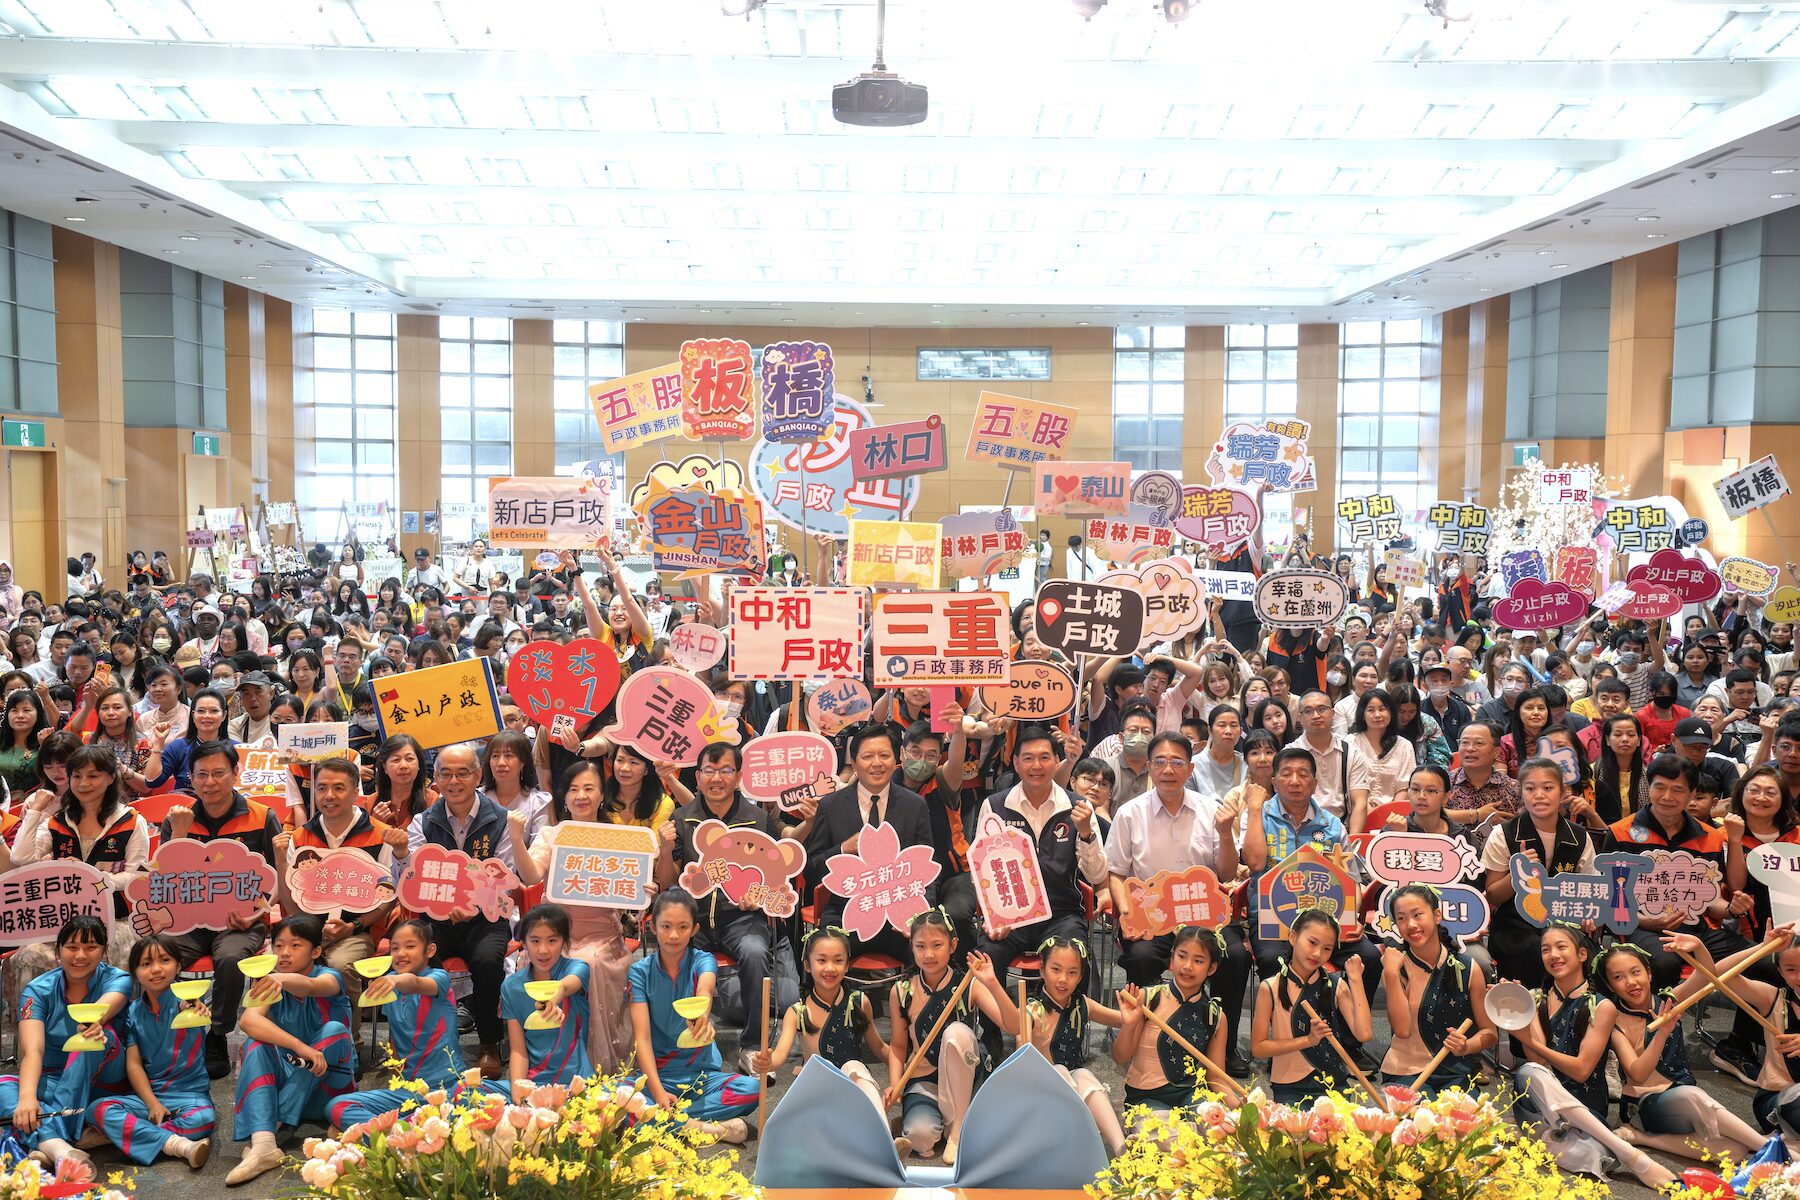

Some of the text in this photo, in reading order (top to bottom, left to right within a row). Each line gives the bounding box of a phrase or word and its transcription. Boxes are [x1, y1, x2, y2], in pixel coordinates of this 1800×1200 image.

[690, 357, 748, 415] 板
[768, 361, 828, 418] 橋
[597, 373, 682, 426] 五股
[610, 415, 680, 444] 戶政事務所
[700, 421, 738, 431] BANQIAO
[778, 422, 818, 433] BANQIAO
[979, 403, 1070, 449] 五股
[863, 431, 932, 471] 林口
[975, 441, 1046, 462] 戶政事務所
[1227, 434, 1281, 461] 瑞芳
[1043, 474, 1124, 498] I 泰山
[1241, 461, 1293, 487] 戶政
[1543, 473, 1571, 487] 中和
[773, 480, 834, 513] 戶政
[1558, 489, 1588, 502] 戶政
[1725, 466, 1782, 510] 板橋
[494, 498, 604, 526] 新店戶政
[650, 496, 743, 535] 金山
[1182, 489, 1234, 518] 瑞芳
[1339, 493, 1395, 521] 中和
[1430, 503, 1487, 529] 中和
[1203, 515, 1251, 541] 戶政
[1350, 519, 1404, 542] 戶政
[1606, 505, 1667, 531] 中和
[1684, 521, 1703, 531] 中和
[491, 530, 547, 540] Let's Celebrate!
[692, 530, 750, 561] 戶政
[942, 531, 1024, 558] 樹林戶政
[1089, 519, 1173, 548] 樹林戶政
[1435, 529, 1490, 556] 戶政
[1617, 530, 1674, 554] 戶政
[663, 552, 718, 566] JINSHAN
[853, 541, 936, 567] 新店戶政
[1559, 556, 1594, 588] 板
[1645, 567, 1706, 584] 汐止戶政
[1063, 586, 1123, 619] 土城
[1272, 581, 1303, 598] 幸福
[740, 595, 811, 631] 中和
[1146, 594, 1190, 616] 戶政
[1284, 598, 1333, 617] 在蘆洲
[1510, 592, 1571, 614] 汐止戶政
[1633, 606, 1660, 614] Xizhi
[880, 597, 1002, 658] 三重
[1523, 611, 1559, 624] Xizhi
[672, 627, 718, 656] 林口
[1061, 620, 1120, 652] 戶政
[520, 648, 596, 682] 淡水
[781, 638, 854, 673] 戶政
[911, 659, 1004, 675] 戶政事務所
[817, 681, 858, 712] 泰山
[1000, 678, 1063, 691] ove in
[645, 685, 696, 728] 三重
[1008, 696, 1045, 713] 永和
[555, 715, 573, 727] 淡水
[289, 734, 337, 749] 土城戶所
[636, 719, 692, 761] 戶政
[748, 745, 825, 768] 三重戶政
[421, 859, 460, 881] 我愛
[564, 854, 641, 877] 新北多元
[704, 858, 731, 886] 熊
[1384, 848, 1444, 872] 我愛
[3, 873, 83, 904] 三重戶政
[149, 870, 263, 904] 新莊戶政
[315, 868, 374, 885] 淡水戶政
[562, 874, 638, 900] 大家庭
[841, 860, 912, 896] 多元新力
[1283, 871, 1332, 893] 世界
[1637, 871, 1704, 886] 板橋戶所
[314, 881, 370, 899] 送幸福!!
[418, 881, 457, 904] 新北
[746, 882, 788, 915] 新北
[858, 879, 927, 913] 幸福未來
[1171, 881, 1208, 903] 新北
[1543, 880, 1610, 900] 一起展現
[1645, 887, 1697, 903] 最給力
[1173, 902, 1211, 925] 愛我
[1550, 900, 1600, 920] 新活力
